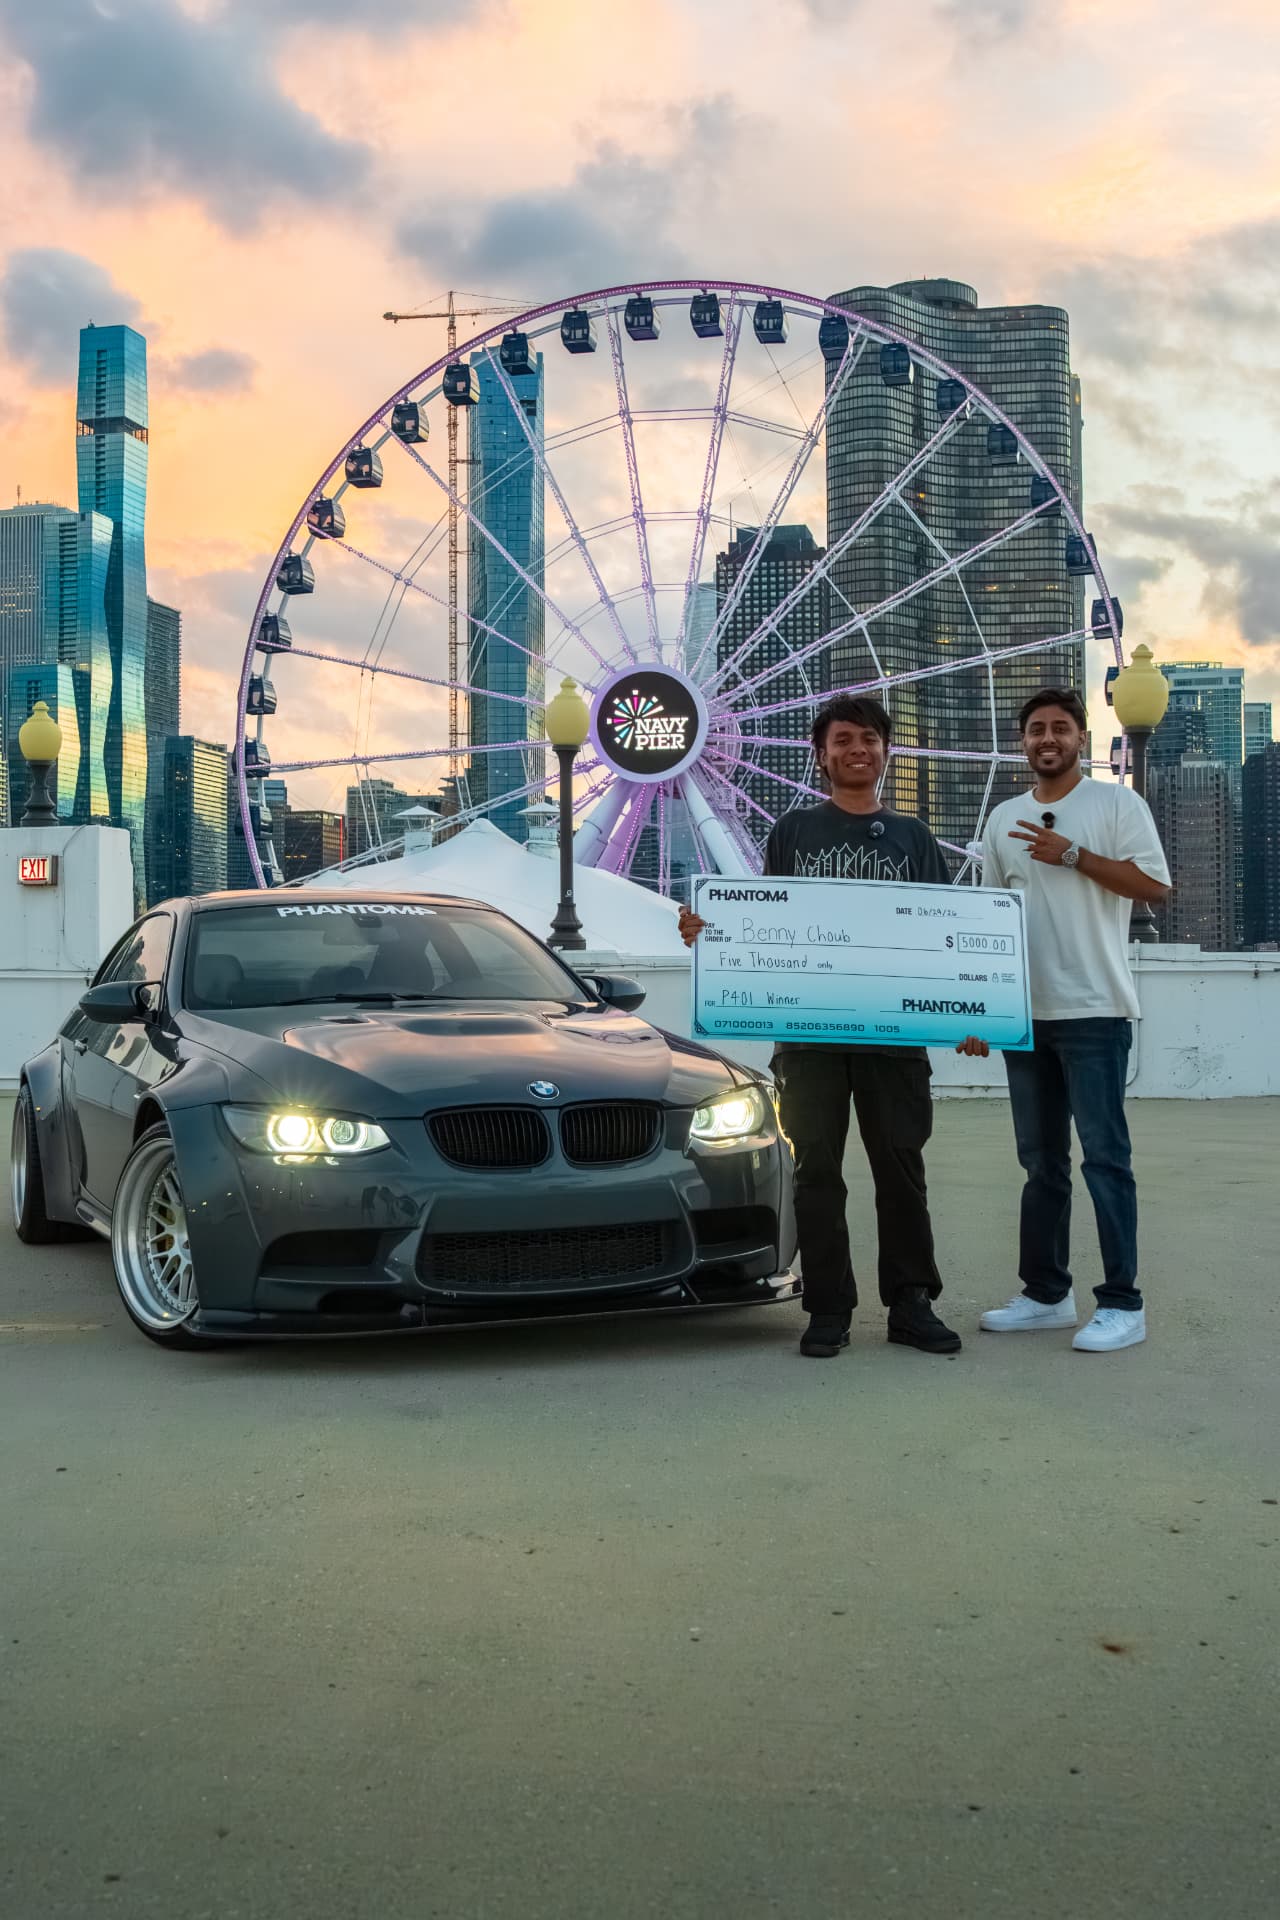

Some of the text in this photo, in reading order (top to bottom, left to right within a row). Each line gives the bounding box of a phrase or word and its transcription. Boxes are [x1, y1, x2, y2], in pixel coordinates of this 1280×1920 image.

[635, 717, 689, 734] NAVY
[635, 734, 686, 751] PIER
[21, 858, 47, 878] EXIT
[709, 889, 789, 902] PHANTOM4
[896, 907, 912, 915] DATE
[993, 900, 1010, 908] 1005
[742, 917, 796, 948] Benny
[719, 951, 833, 971] Five Thousand only
[959, 973, 988, 982] DOLLARS
[766, 991, 801, 1005] Winner
[902, 998, 986, 1015] PHANTOM4
[714, 1020, 774, 1029] 071000013
[874, 1025, 900, 1033] 1005
